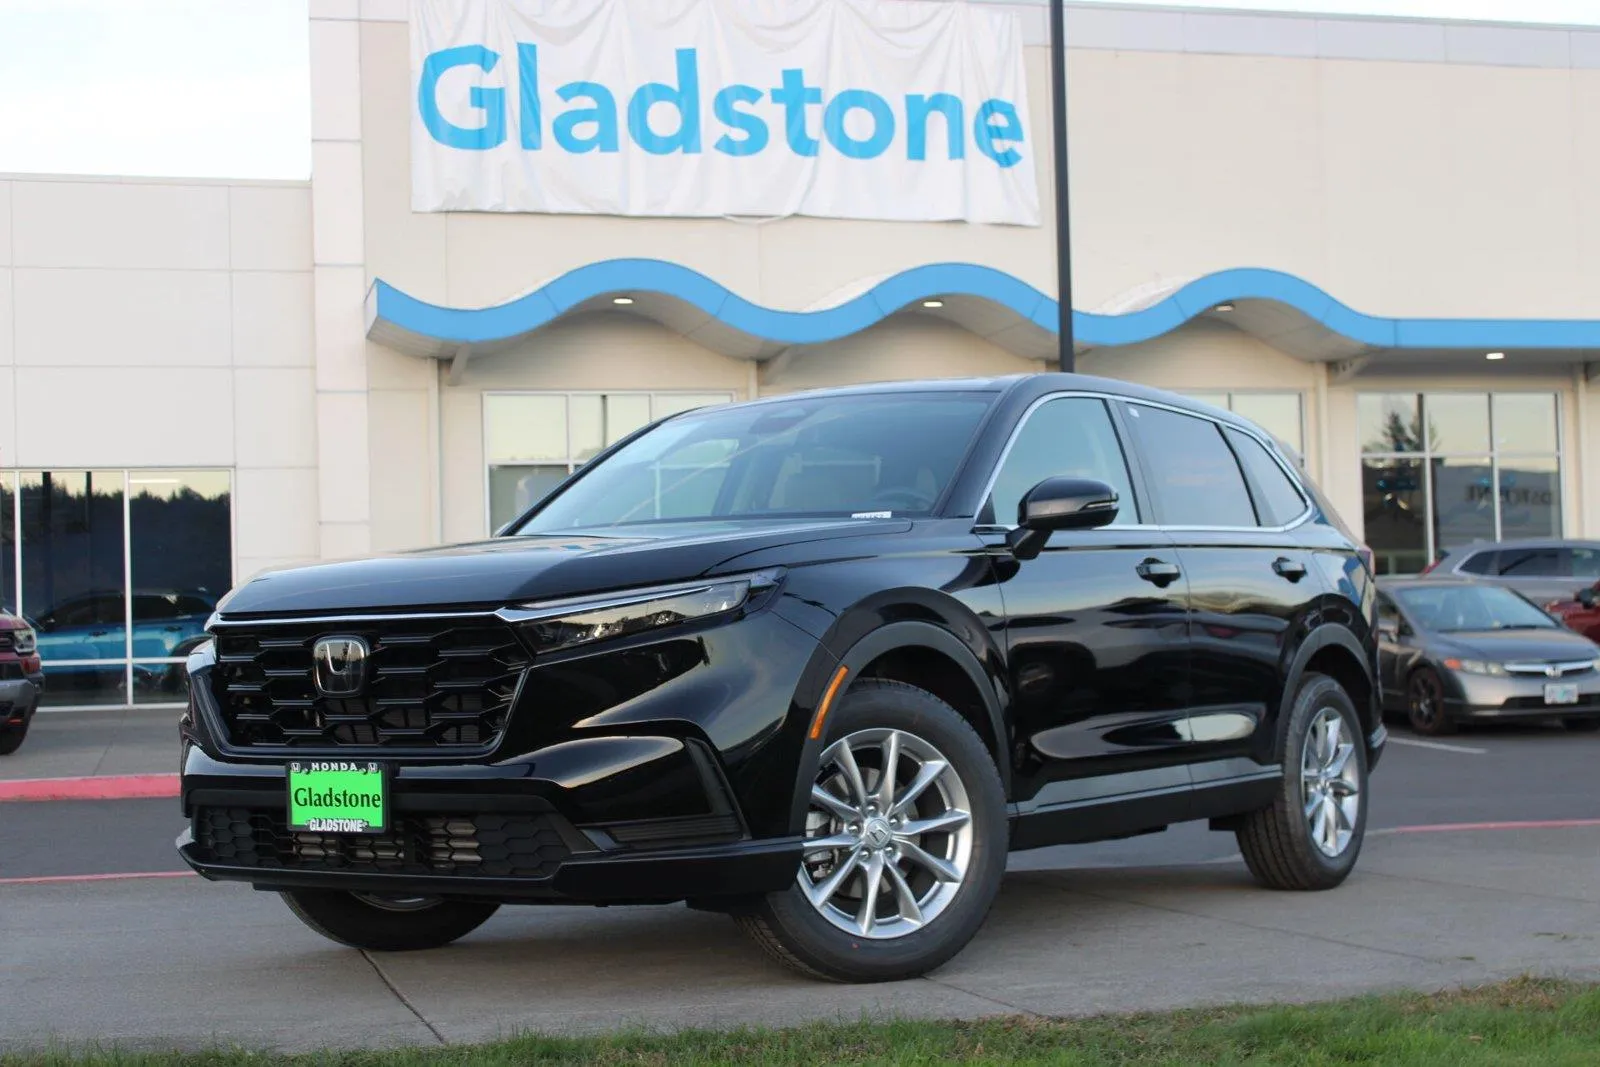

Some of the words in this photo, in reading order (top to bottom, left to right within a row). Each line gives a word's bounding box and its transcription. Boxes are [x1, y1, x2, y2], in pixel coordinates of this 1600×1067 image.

[418, 42, 1024, 168] Gladstone
[311, 762, 357, 771] HONDA
[294, 787, 381, 808] Gladstone
[309, 819, 364, 832] GLADSTONE
